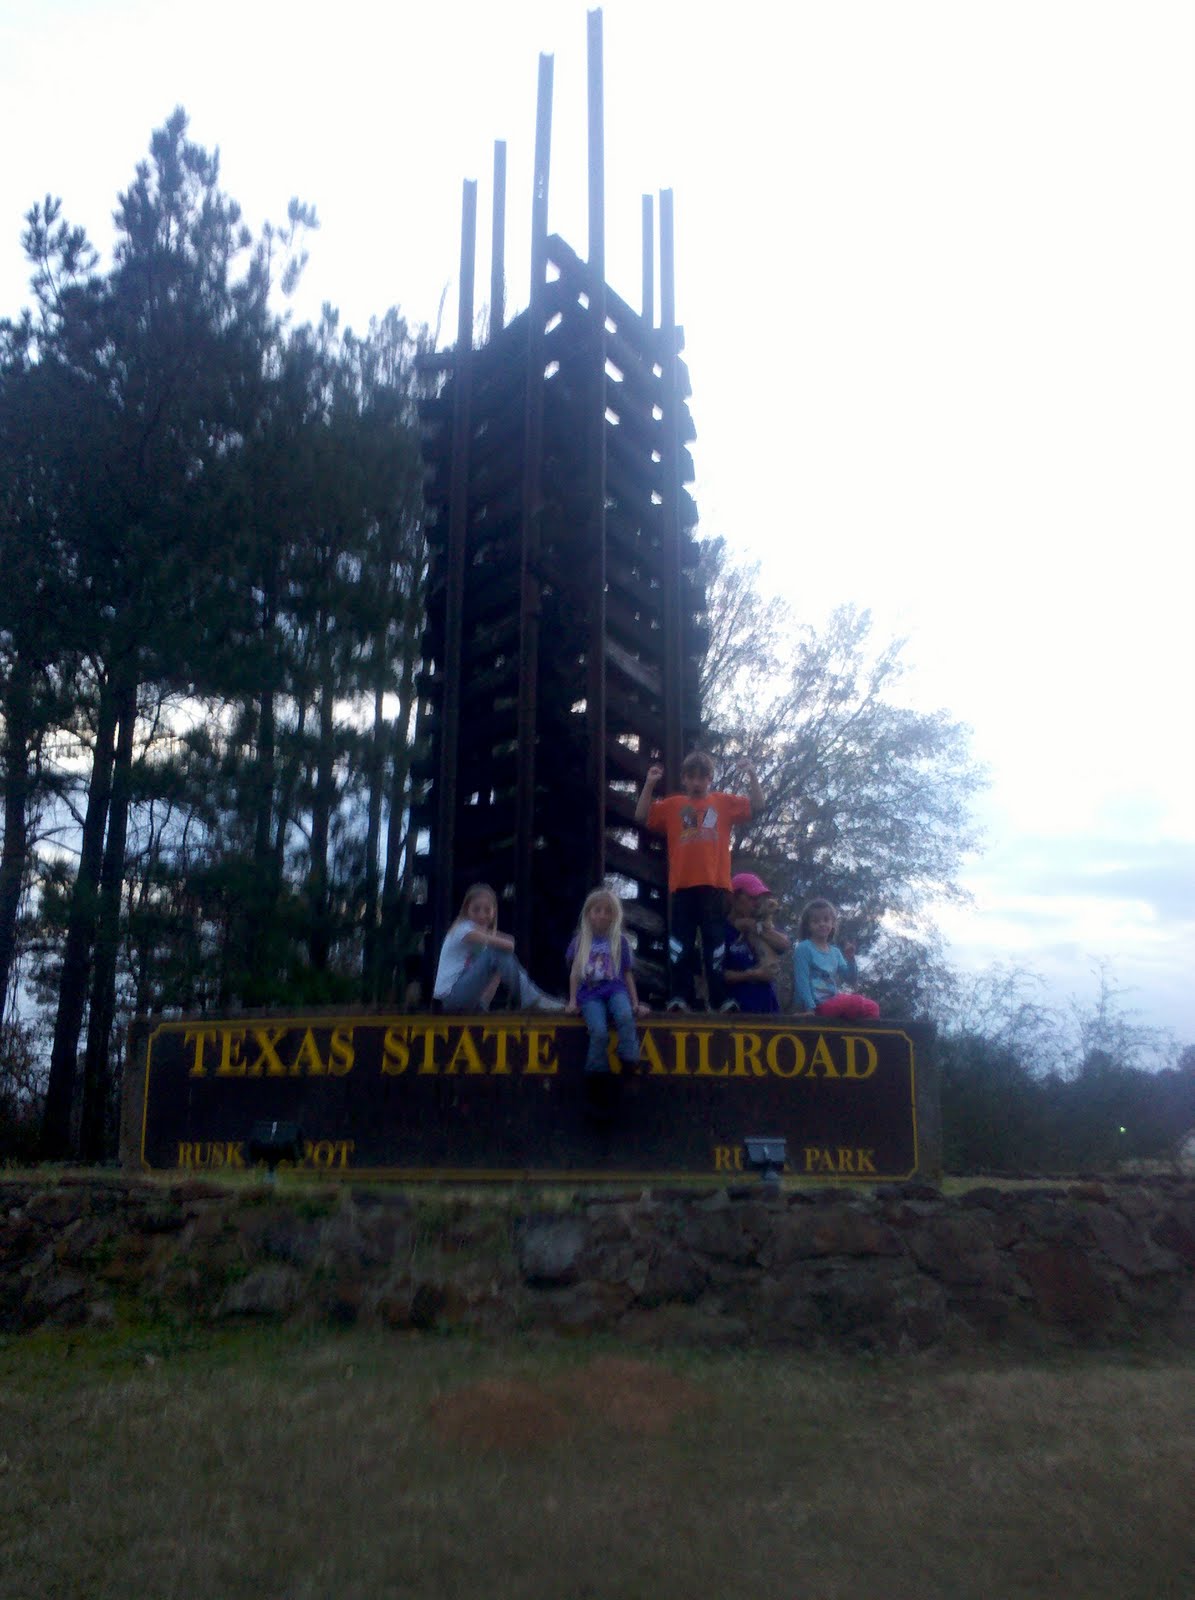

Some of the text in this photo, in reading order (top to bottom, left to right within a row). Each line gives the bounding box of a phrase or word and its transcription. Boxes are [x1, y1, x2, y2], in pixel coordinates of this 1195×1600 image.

[184, 1025, 355, 1077] TEXAS
[381, 1025, 559, 1076] STATE
[802, 1145, 878, 1173] PARK
